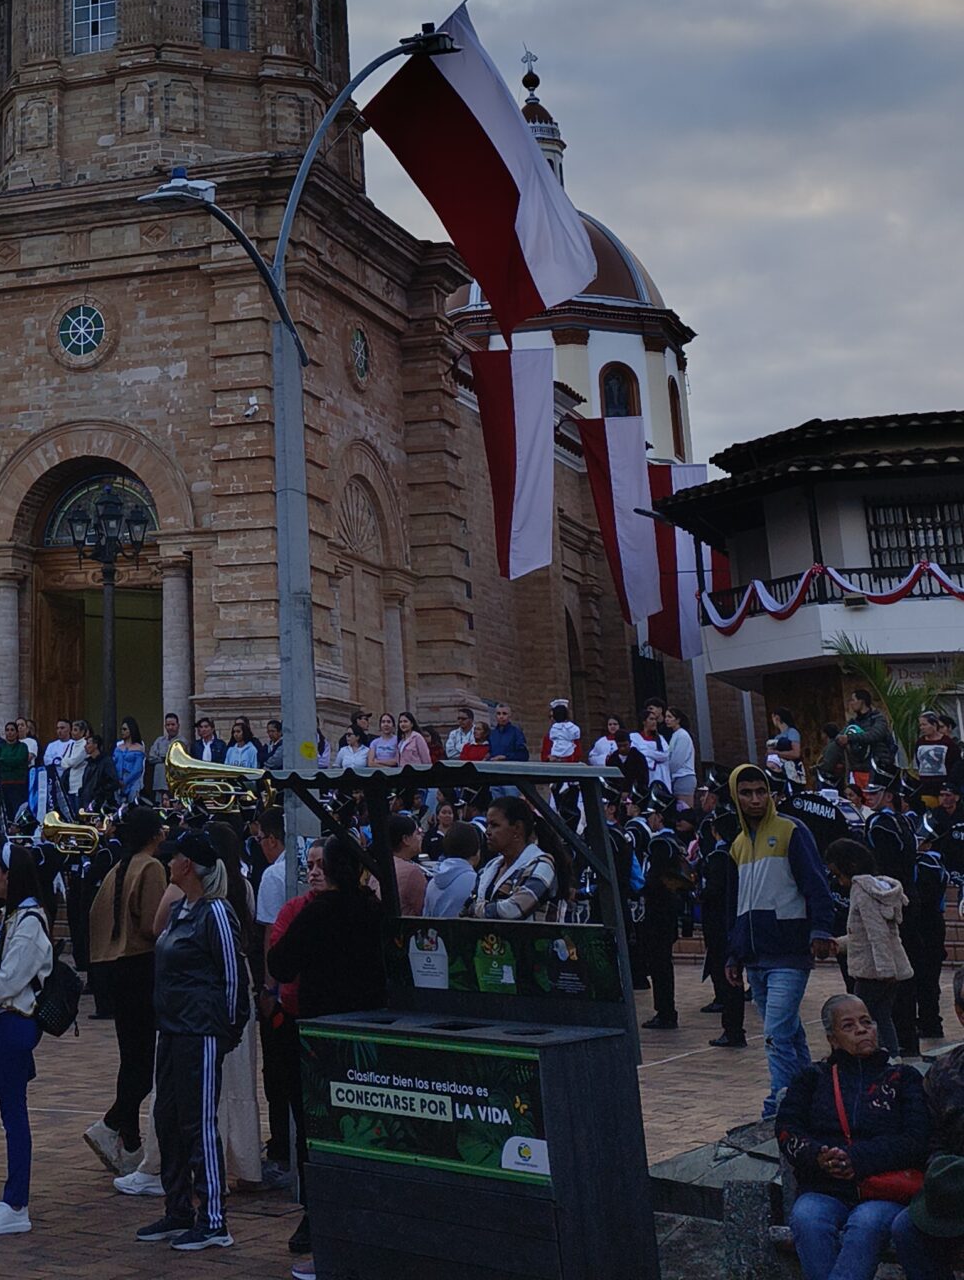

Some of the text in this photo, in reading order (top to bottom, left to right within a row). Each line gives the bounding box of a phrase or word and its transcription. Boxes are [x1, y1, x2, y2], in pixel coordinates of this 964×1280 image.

[803, 800, 836, 820] YAMAHA
[346, 1069, 489, 1097] Clasificar bien los residuos es
[335, 1087, 513, 1126] CONECTARSE POR LA VIDA
